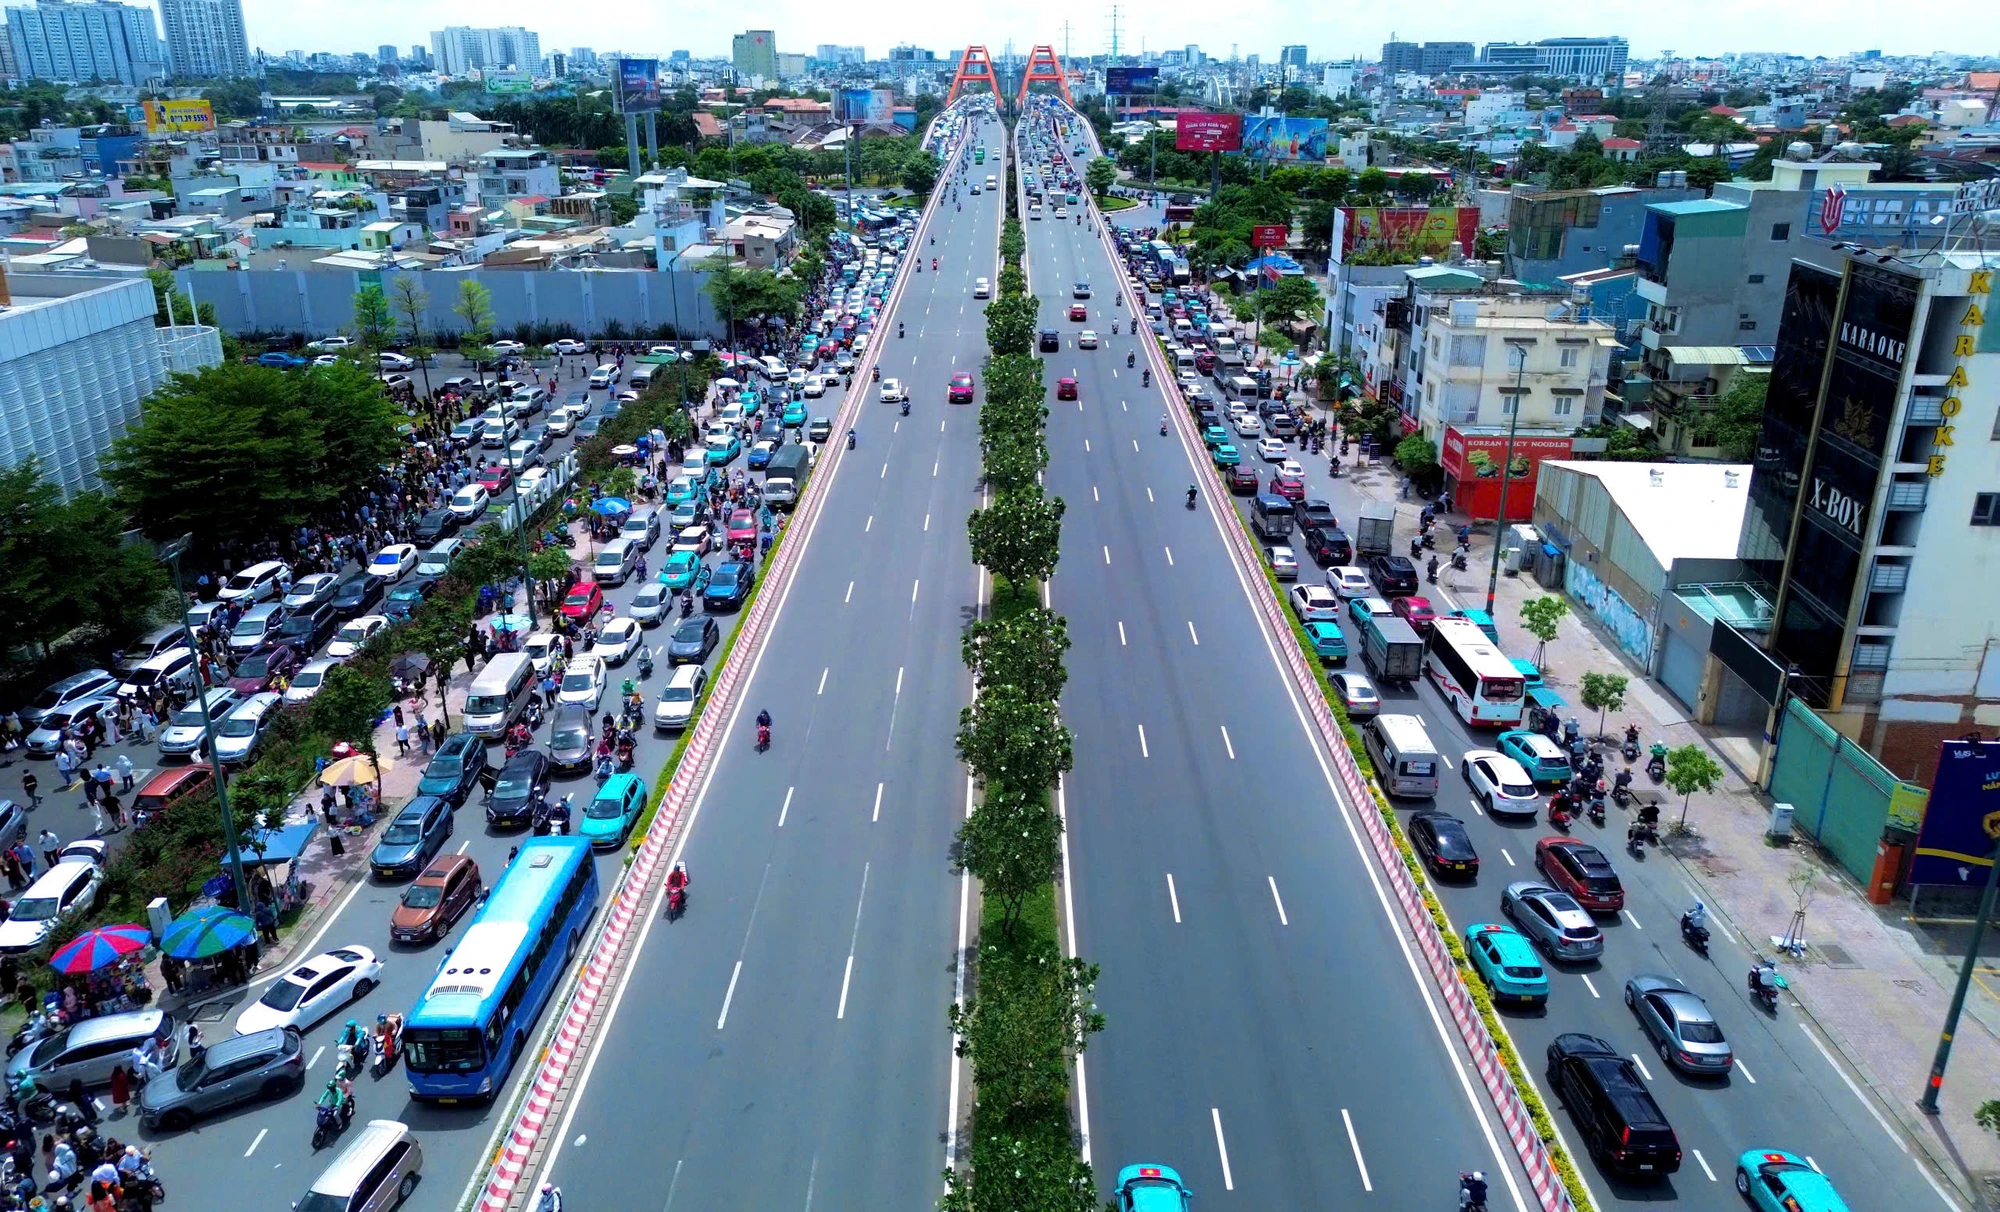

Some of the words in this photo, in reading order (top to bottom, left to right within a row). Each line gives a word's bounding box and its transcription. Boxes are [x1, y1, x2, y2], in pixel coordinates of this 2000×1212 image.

[1840, 321, 1905, 363] KARAOKE
[1926, 271, 1992, 477] KARAOKE
[1809, 477, 1865, 535] X-BOX
[1985, 771, 2000, 781] LU
